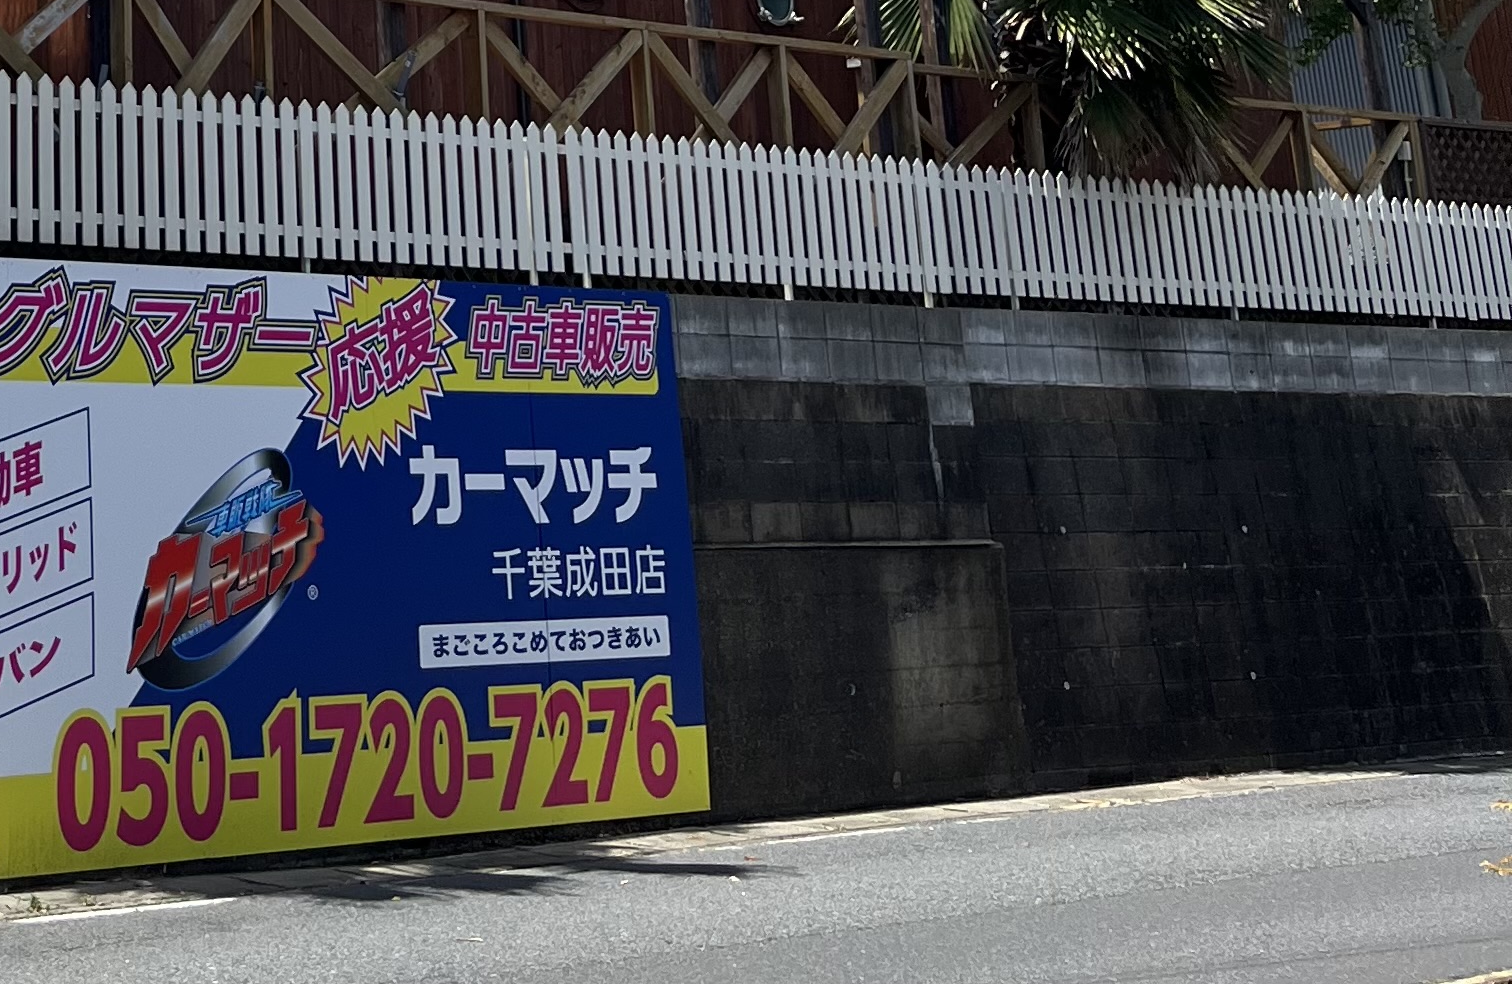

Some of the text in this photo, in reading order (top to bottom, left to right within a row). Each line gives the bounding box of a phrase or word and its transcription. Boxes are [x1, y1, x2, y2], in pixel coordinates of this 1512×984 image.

[328, 283, 439, 423] 応援
[469, 297, 657, 385] 中古車販売
[409, 445, 658, 526] カーマッチ
[126, 499, 310, 674] カーマッチ
[492, 544, 666, 600] 千葉成田店
[432, 626, 662, 658] まごころこめておつきあい
[54, 674, 681, 853] 050-1720-7276
